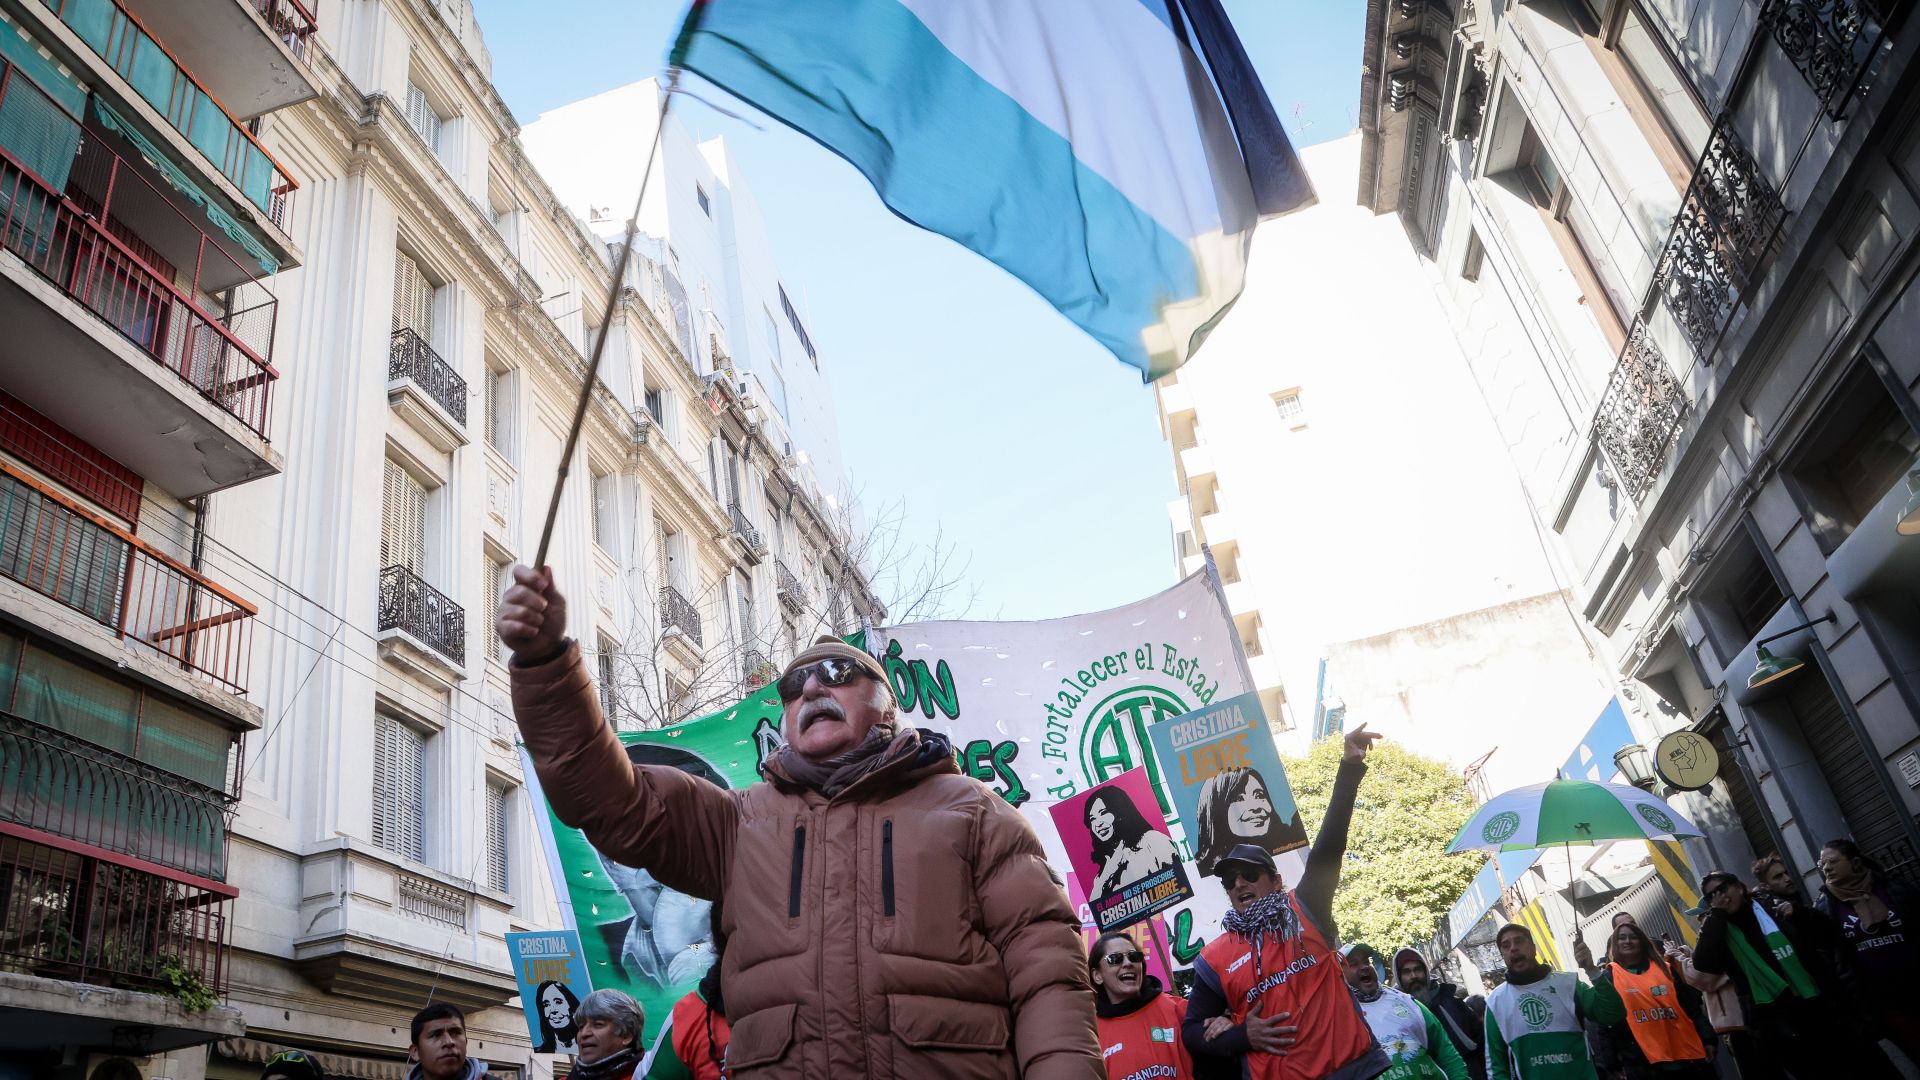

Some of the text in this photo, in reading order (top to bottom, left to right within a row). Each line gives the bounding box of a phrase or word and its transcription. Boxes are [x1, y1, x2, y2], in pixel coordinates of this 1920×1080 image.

[882, 638, 960, 720] ÓN
[1042, 643, 1219, 762] Fortalecer el Estad
[1170, 705, 1246, 748] CRISTINA
[957, 740, 1031, 808] ES
[1179, 732, 1254, 787] LIBRE
[1100, 892, 1151, 926] CRISTINA
[1149, 877, 1179, 903] LIBRE
[1122, 888, 1132, 899] NO
[1132, 884, 1142, 895] SE
[1140, 868, 1175, 890] PROSCRIBE
[518, 936, 568, 955] CRISTINA
[1856, 933, 1904, 951] UNIVERSITY
[524, 958, 571, 985] LIBRE
[1632, 1008, 1649, 1024] LA
